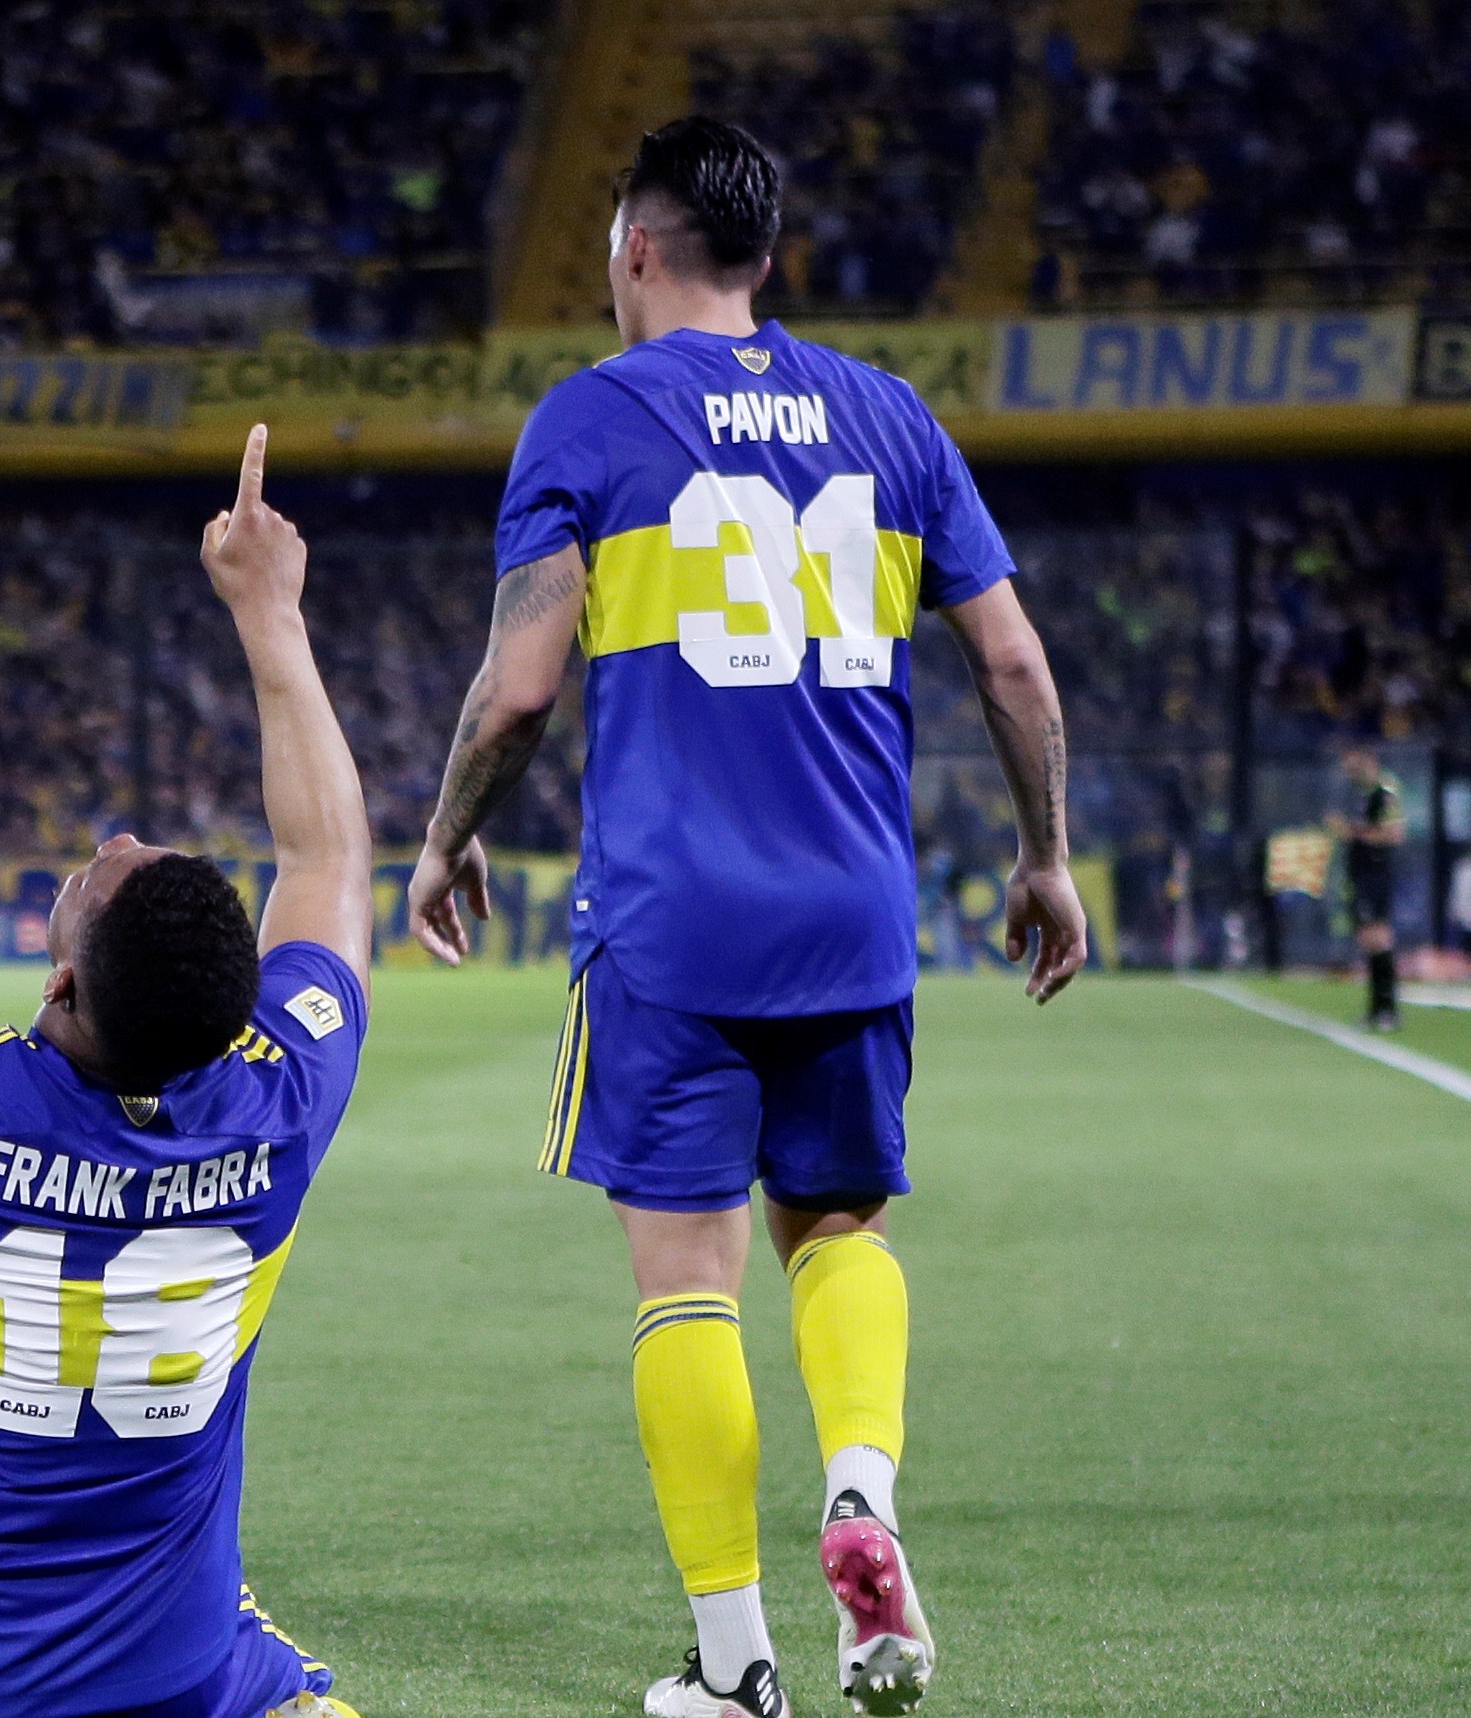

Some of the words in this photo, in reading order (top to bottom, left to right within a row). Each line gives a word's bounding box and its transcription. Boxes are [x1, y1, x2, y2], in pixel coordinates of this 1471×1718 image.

[999, 315, 1368, 408] LANUS
[703, 392, 829, 445] PAVON
[669, 472, 894, 688] 31
[730, 654, 770, 668] CABJ
[144, 1141, 273, 1219] FABRA
[0, 1399, 51, 1419] CABJ
[145, 1403, 190, 1420] CABJ
